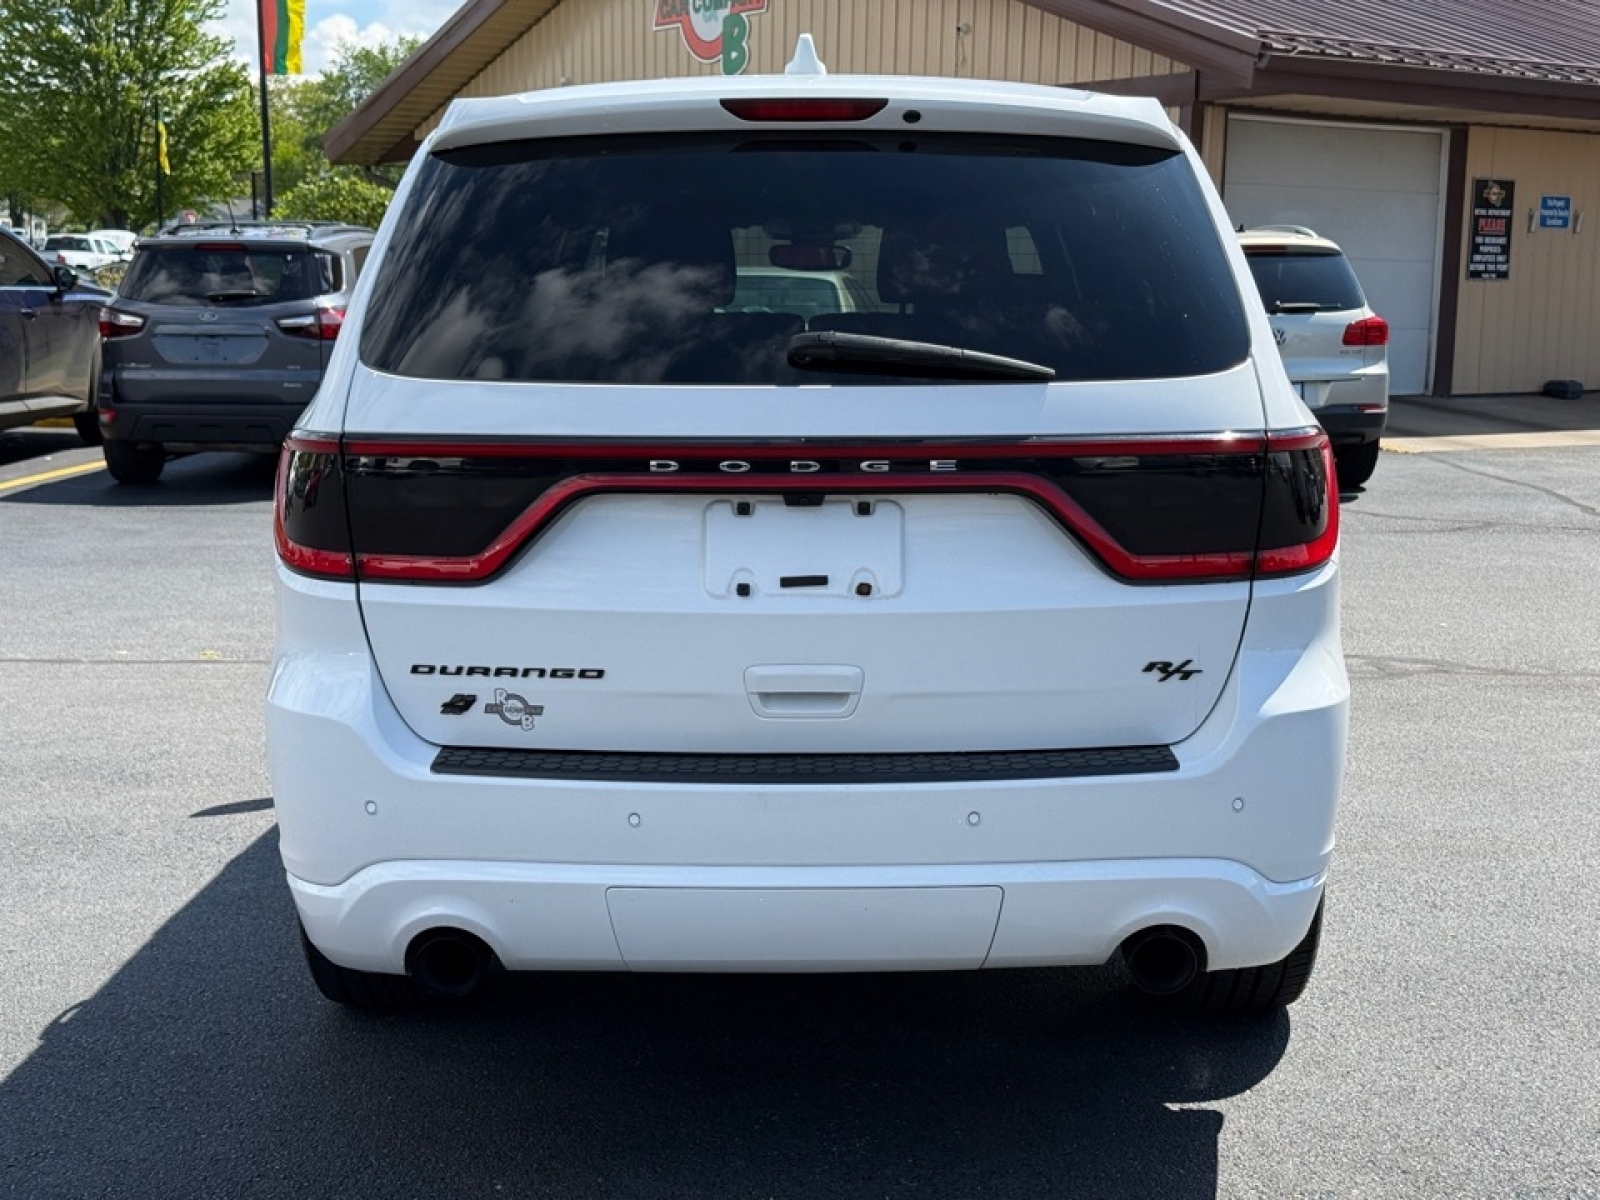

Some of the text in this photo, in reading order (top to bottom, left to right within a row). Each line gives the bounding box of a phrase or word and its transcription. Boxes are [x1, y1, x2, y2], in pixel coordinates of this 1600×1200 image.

[649, 459, 958, 472] DODGE
[409, 664, 606, 679] DURANGO
[1141, 659, 1204, 683] R/T
